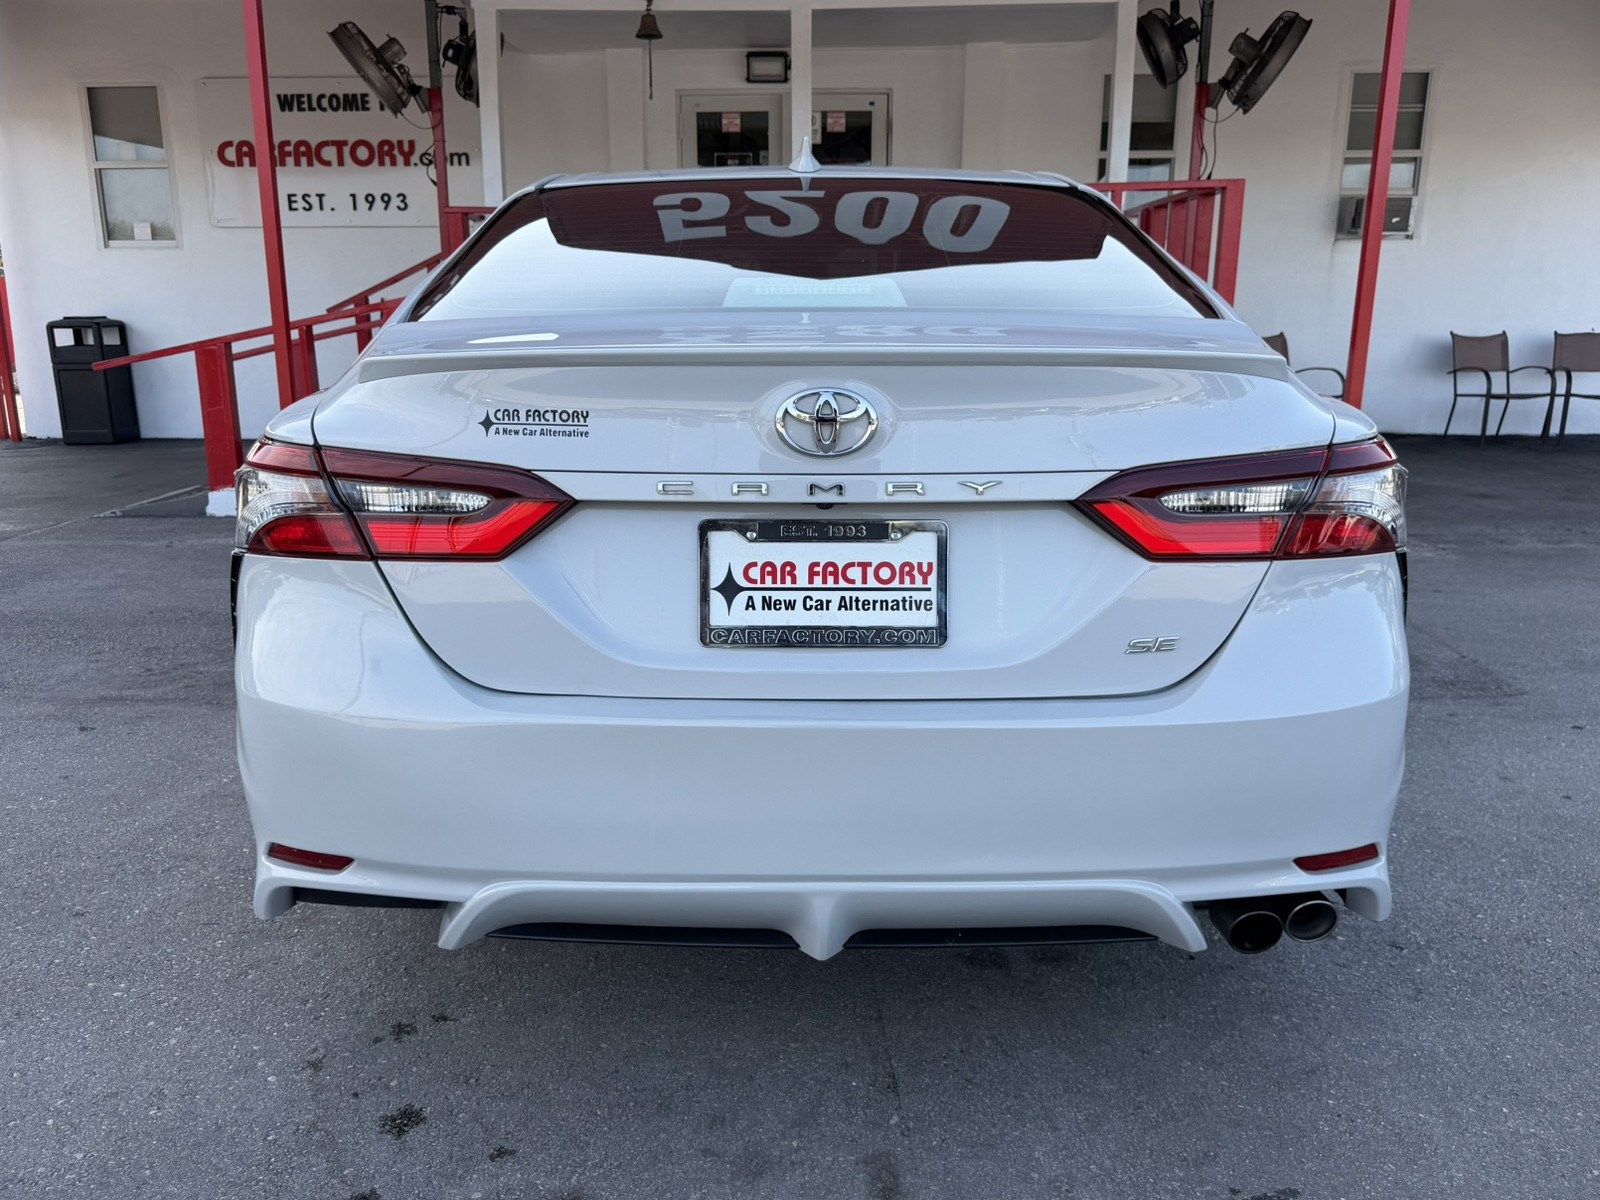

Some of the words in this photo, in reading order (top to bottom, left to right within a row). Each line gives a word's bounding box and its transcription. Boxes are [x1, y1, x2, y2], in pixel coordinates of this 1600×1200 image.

[276, 93, 370, 112] WELCOME
[287, 193, 335, 212] EST.
[349, 193, 408, 211] 1993
[494, 408, 520, 422] CAR
[525, 409, 589, 423] FACTORY
[494, 427, 500, 436] A
[502, 427, 520, 436] New
[522, 427, 537, 437] Car
[540, 428, 589, 438] Alternative
[656, 480, 1003, 496] CAMRY
[780, 524, 818, 537] EST.
[824, 524, 866, 537] 1993
[742, 560, 797, 585] CAR
[807, 560, 934, 586] FACTORY
[744, 595, 756, 611] A
[761, 595, 797, 611] New
[802, 595, 832, 611] Car
[837, 595, 933, 612] Alternative
[709, 628, 938, 644] CARFACTORY.COM
[1124, 635, 1180, 654] SE
